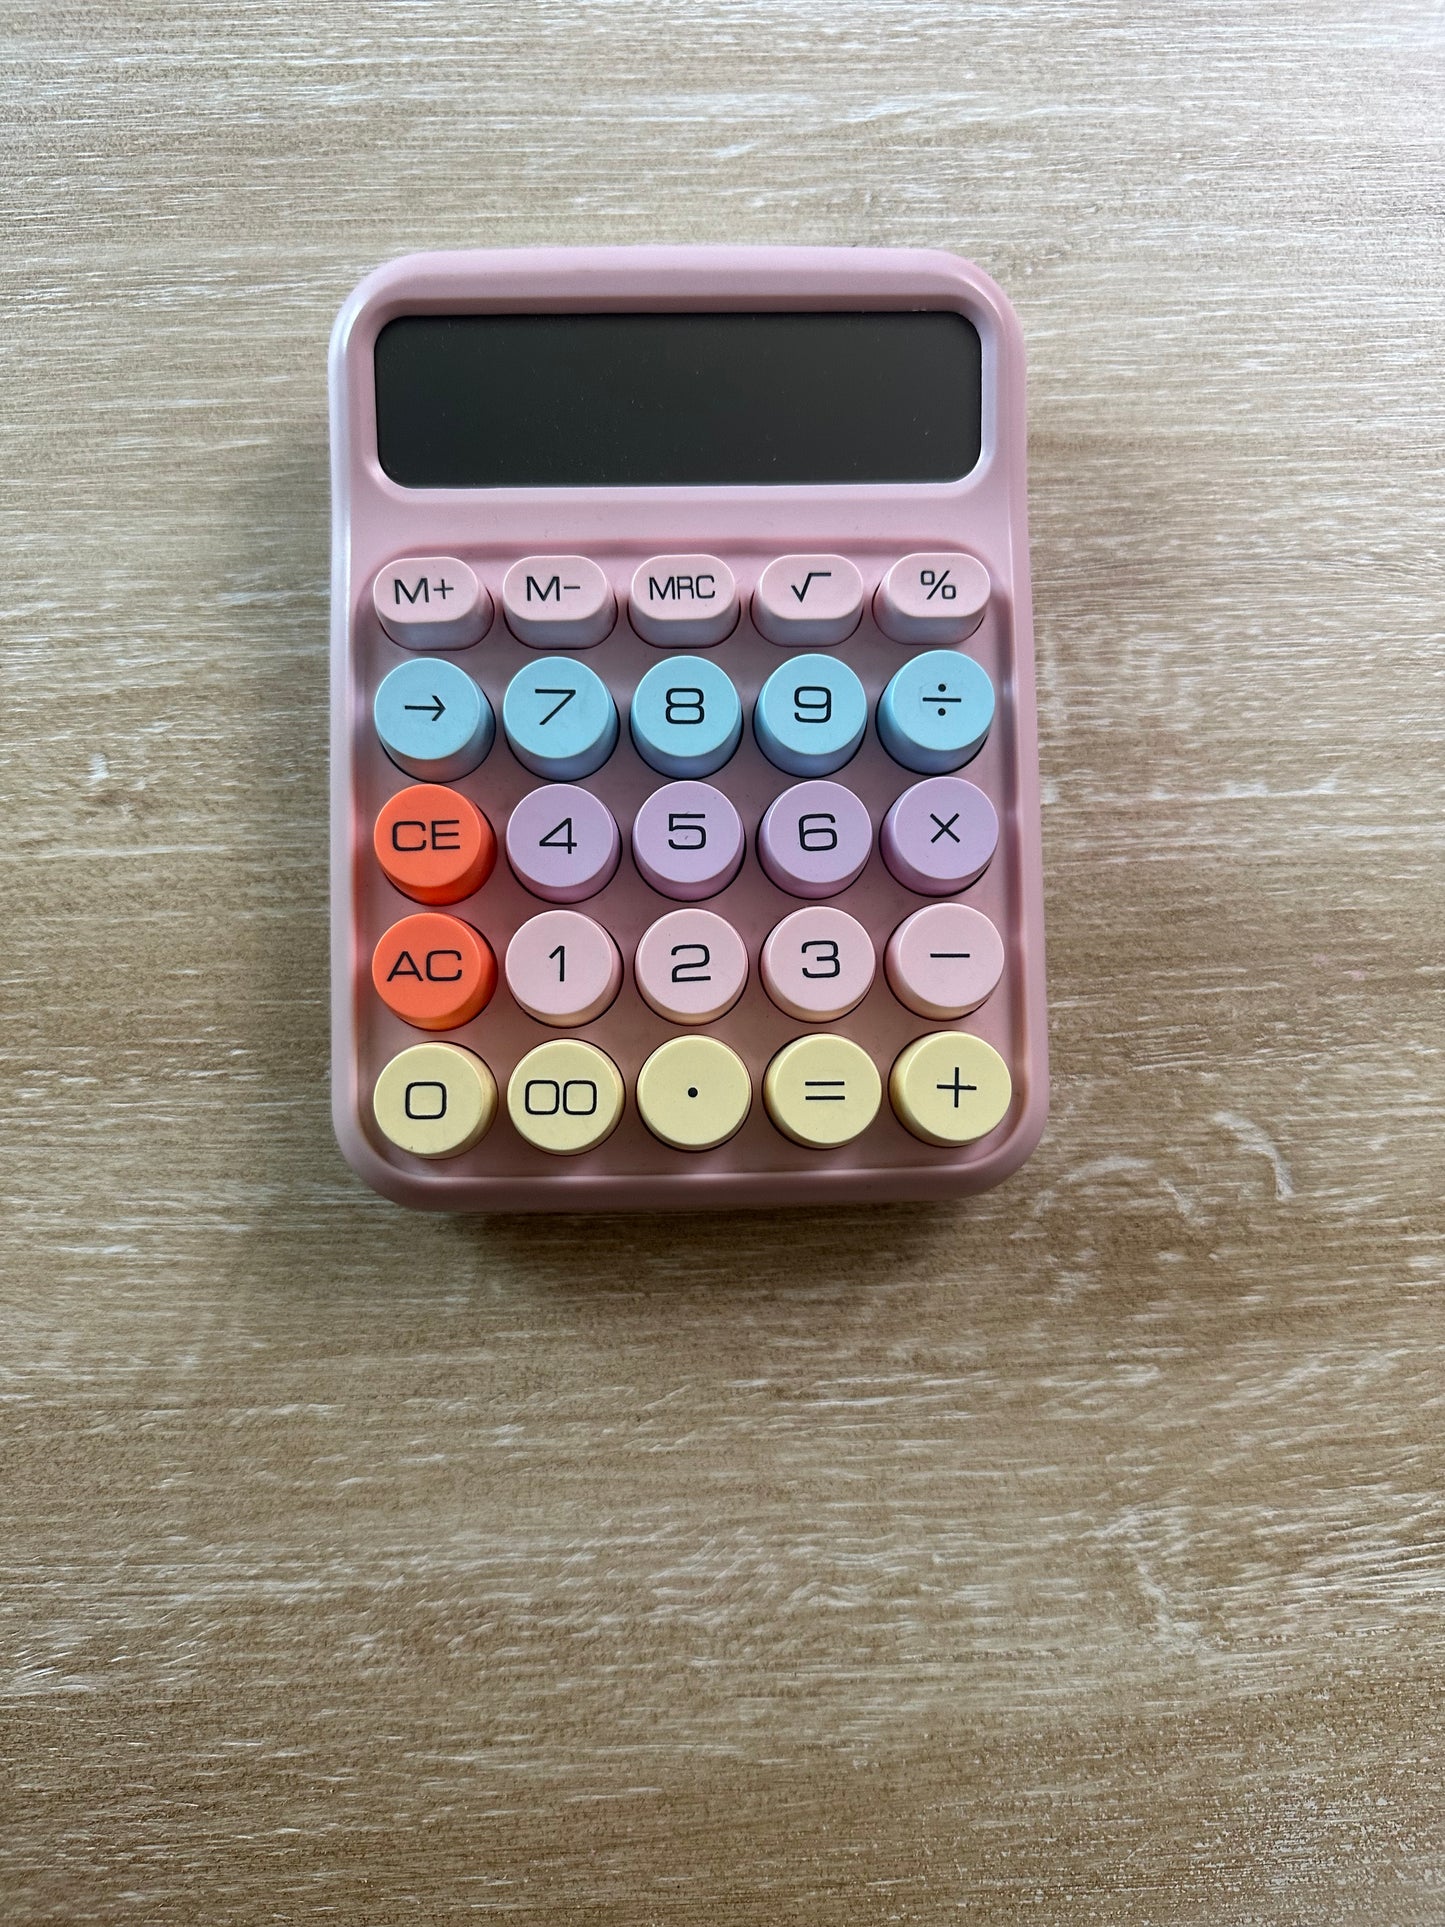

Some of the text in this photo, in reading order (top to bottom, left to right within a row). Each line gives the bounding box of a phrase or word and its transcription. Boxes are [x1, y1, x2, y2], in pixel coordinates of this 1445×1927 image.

[393, 577, 454, 605] M+
[526, 575, 581, 602] M-
[648, 574, 716, 601] MRC
[920, 569, 957, 600] %
[534, 688, 577, 726] 7
[665, 687, 705, 725] 8
[793, 685, 832, 724] 9
[391, 819, 461, 852] CE
[538, 817, 578, 855] 4
[667, 813, 707, 850] 5
[798, 813, 838, 852] 6
[386, 949, 463, 983] AC
[548, 945, 566, 983] 1
[670, 943, 712, 983] 2
[801, 940, 841, 979] 3
[404, 1081, 448, 1121] 0
[524, 1079, 598, 1116] 00
